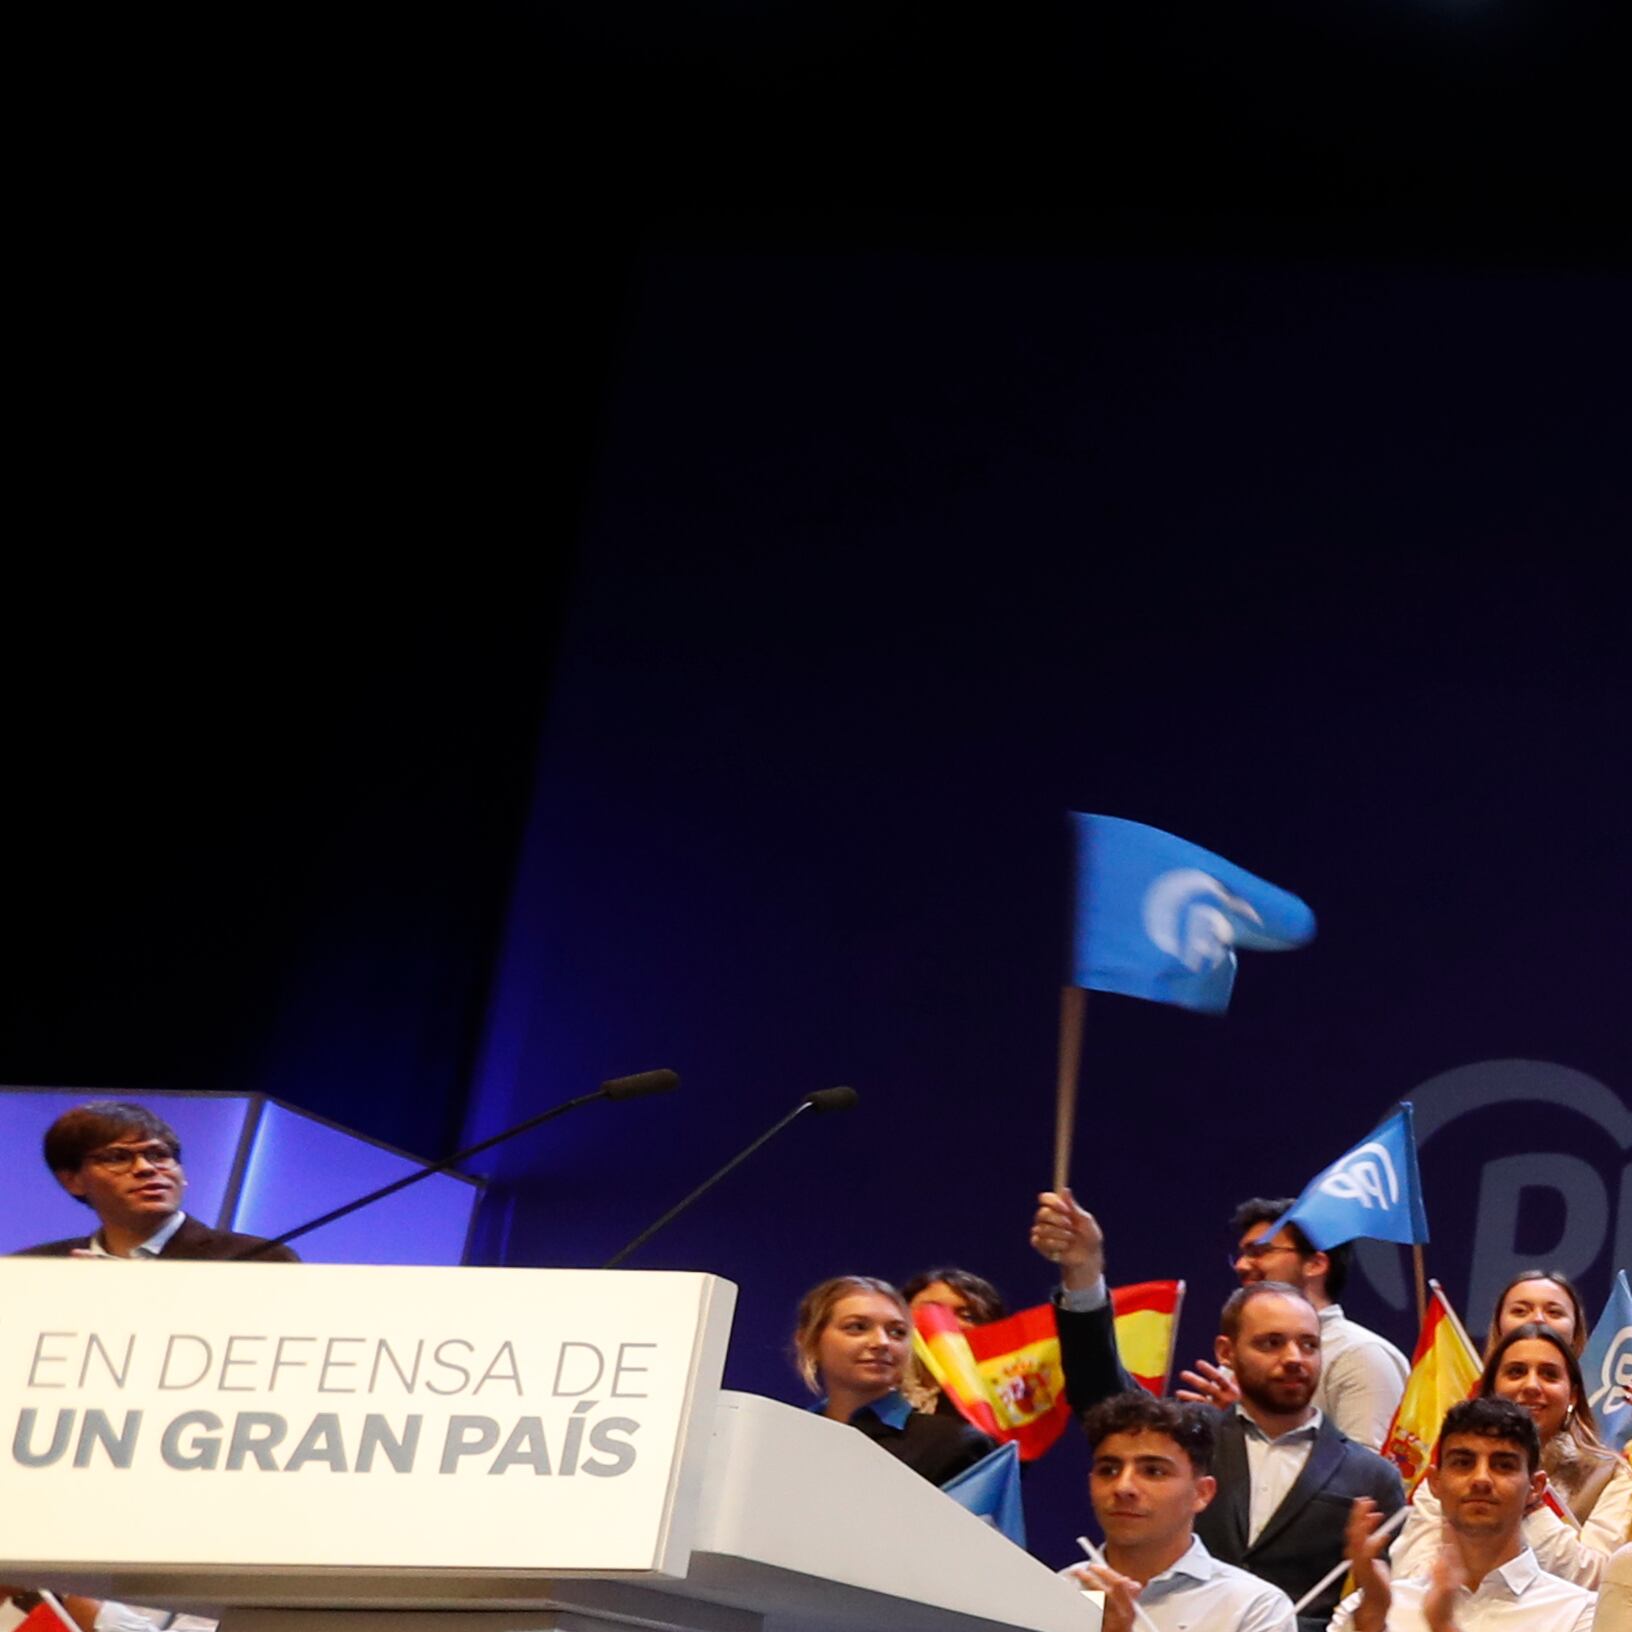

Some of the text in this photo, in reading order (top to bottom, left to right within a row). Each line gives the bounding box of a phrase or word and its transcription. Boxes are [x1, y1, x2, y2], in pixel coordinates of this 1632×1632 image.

[27, 1332, 657, 1399] EN DEFENSA DE
[11, 1400, 641, 1478] UN GRAN PAÍS
